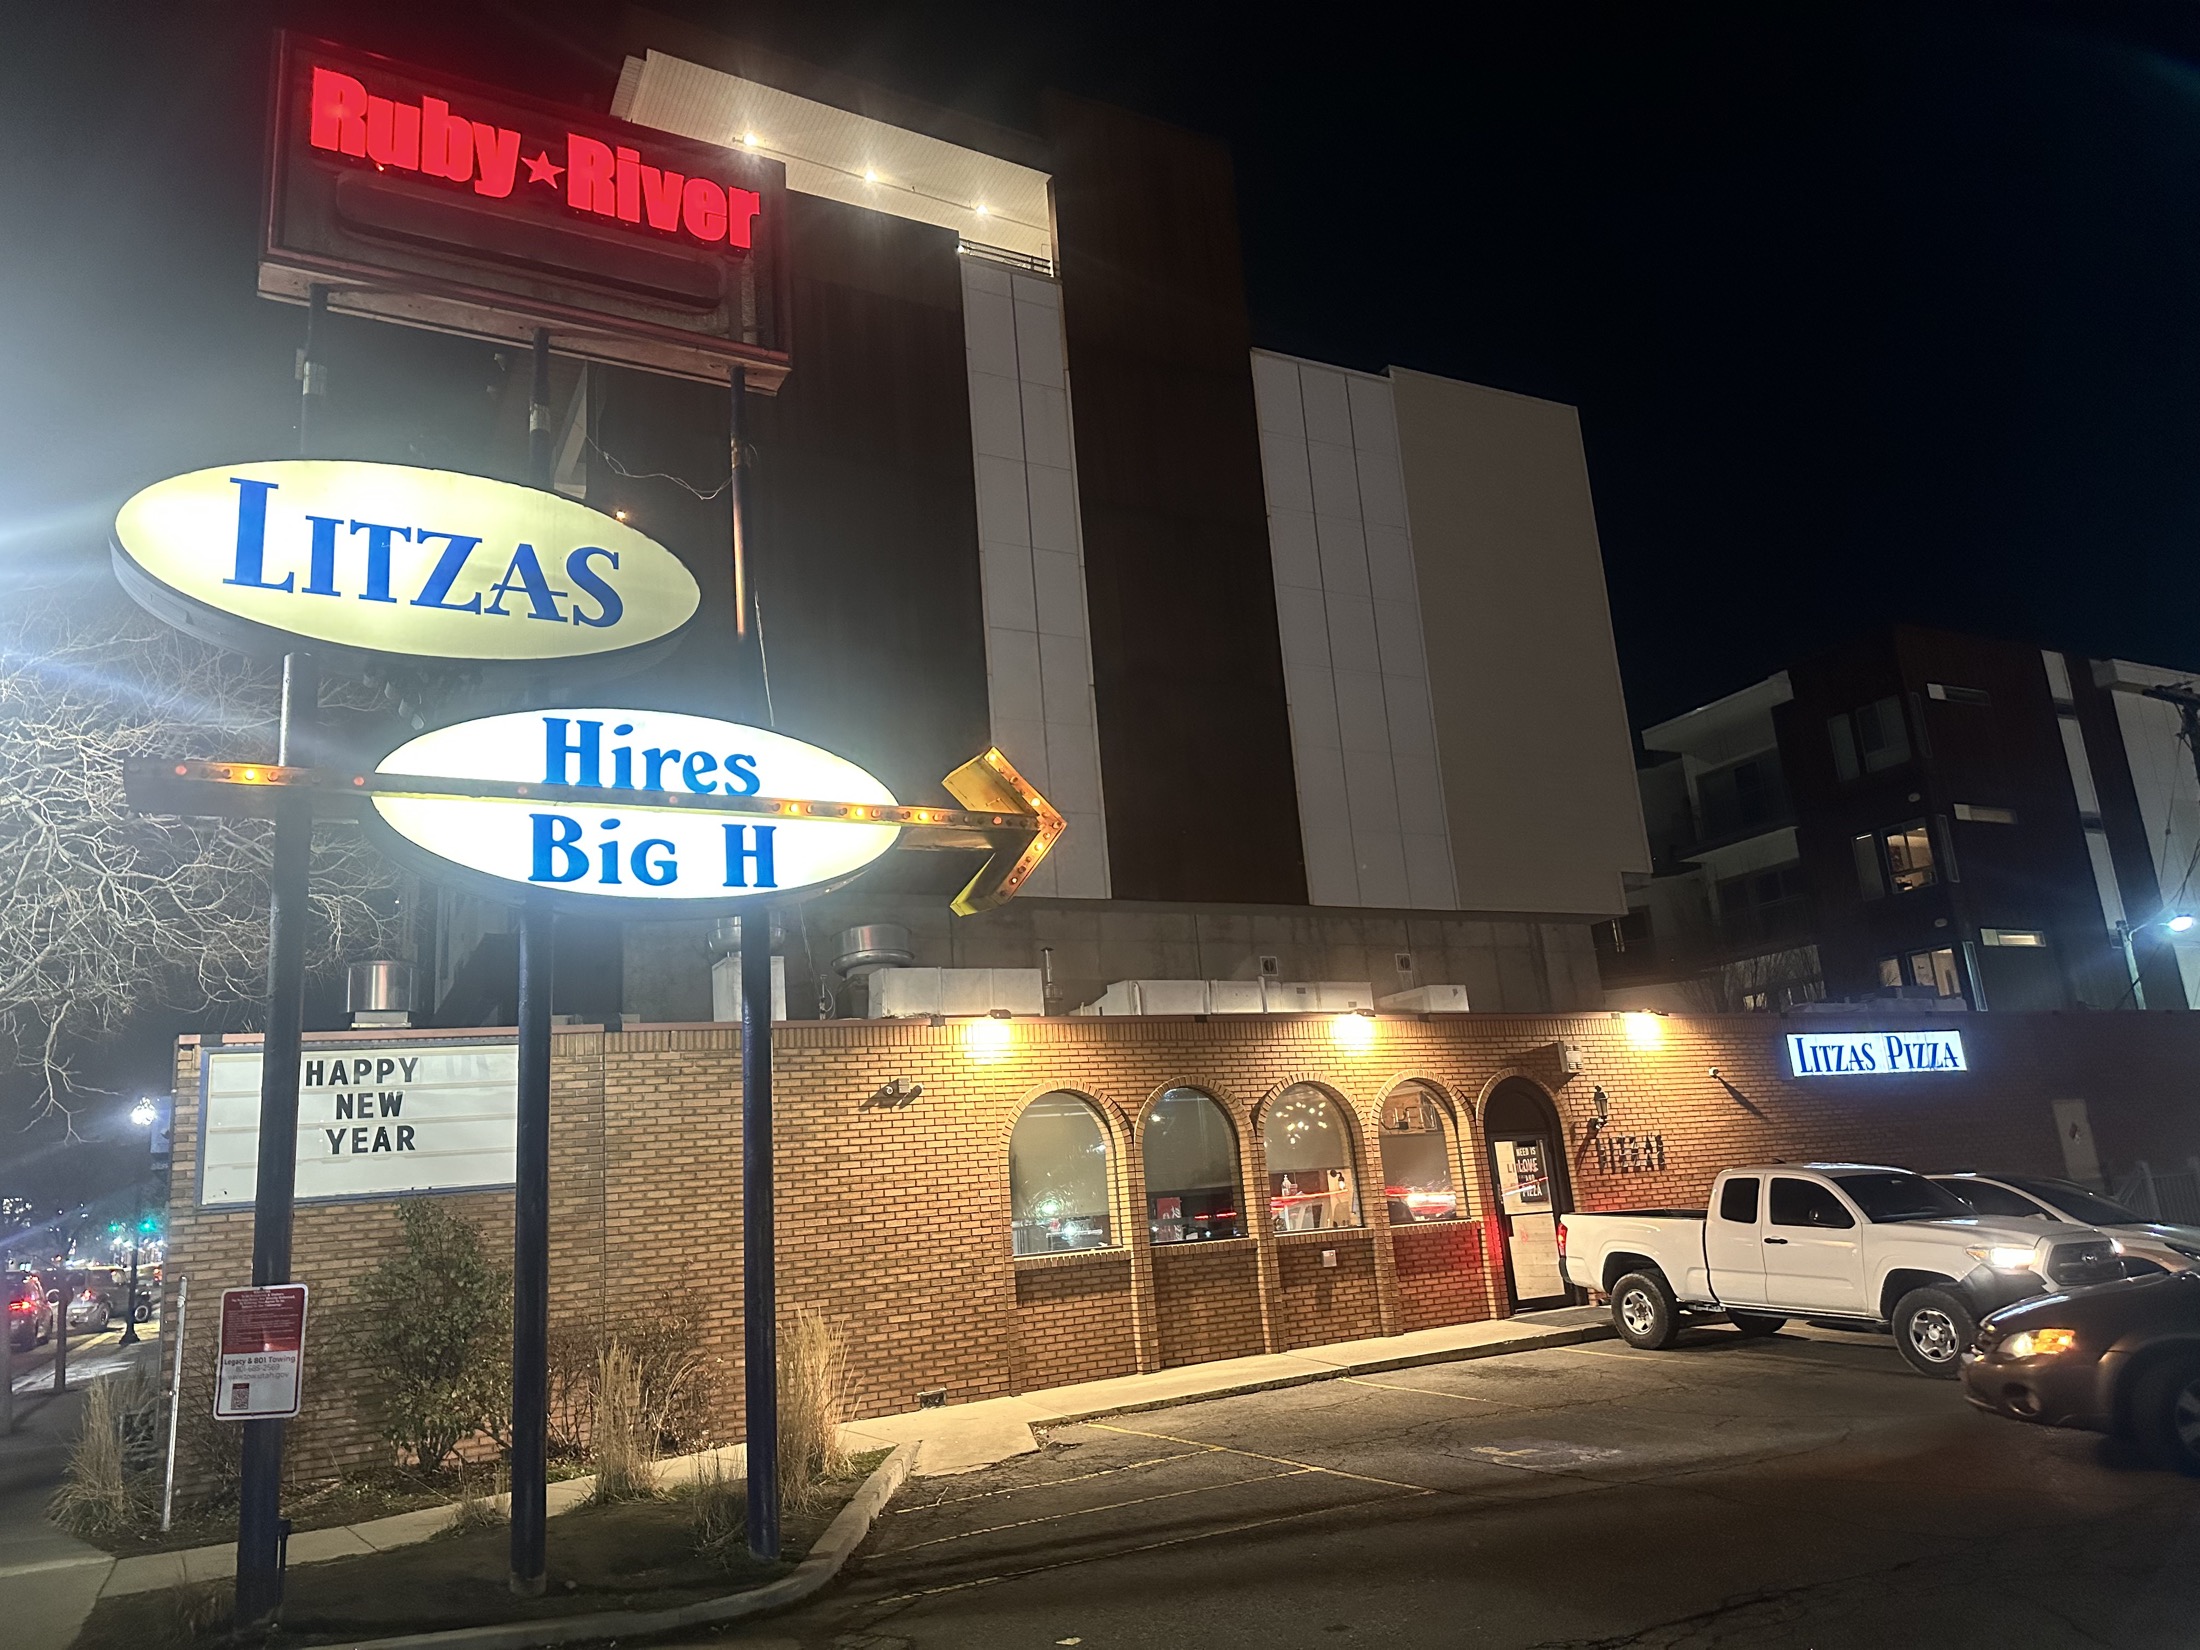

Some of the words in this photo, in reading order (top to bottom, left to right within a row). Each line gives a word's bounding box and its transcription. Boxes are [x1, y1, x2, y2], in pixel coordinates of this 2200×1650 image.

[310, 66, 521, 200] Ruby
[567, 132, 760, 249] River
[222, 477, 624, 628] LITZAS
[542, 717, 760, 797] Hires
[722, 823, 777, 888] H
[1794, 1037, 1876, 1073] LITZAS
[1884, 1035, 1960, 1070] PIZZA
[305, 1057, 419, 1087] HAPPY
[335, 1090, 404, 1120] NEW
[325, 1124, 416, 1155] YEAR
[1515, 1147, 1529, 1156] NEED
[1529, 1146, 1536, 1155] IS
[1517, 1158, 1538, 1173] LOVE
[224, 1358, 246, 1366] Legacy
[268, 1355, 296, 1363] Towing
